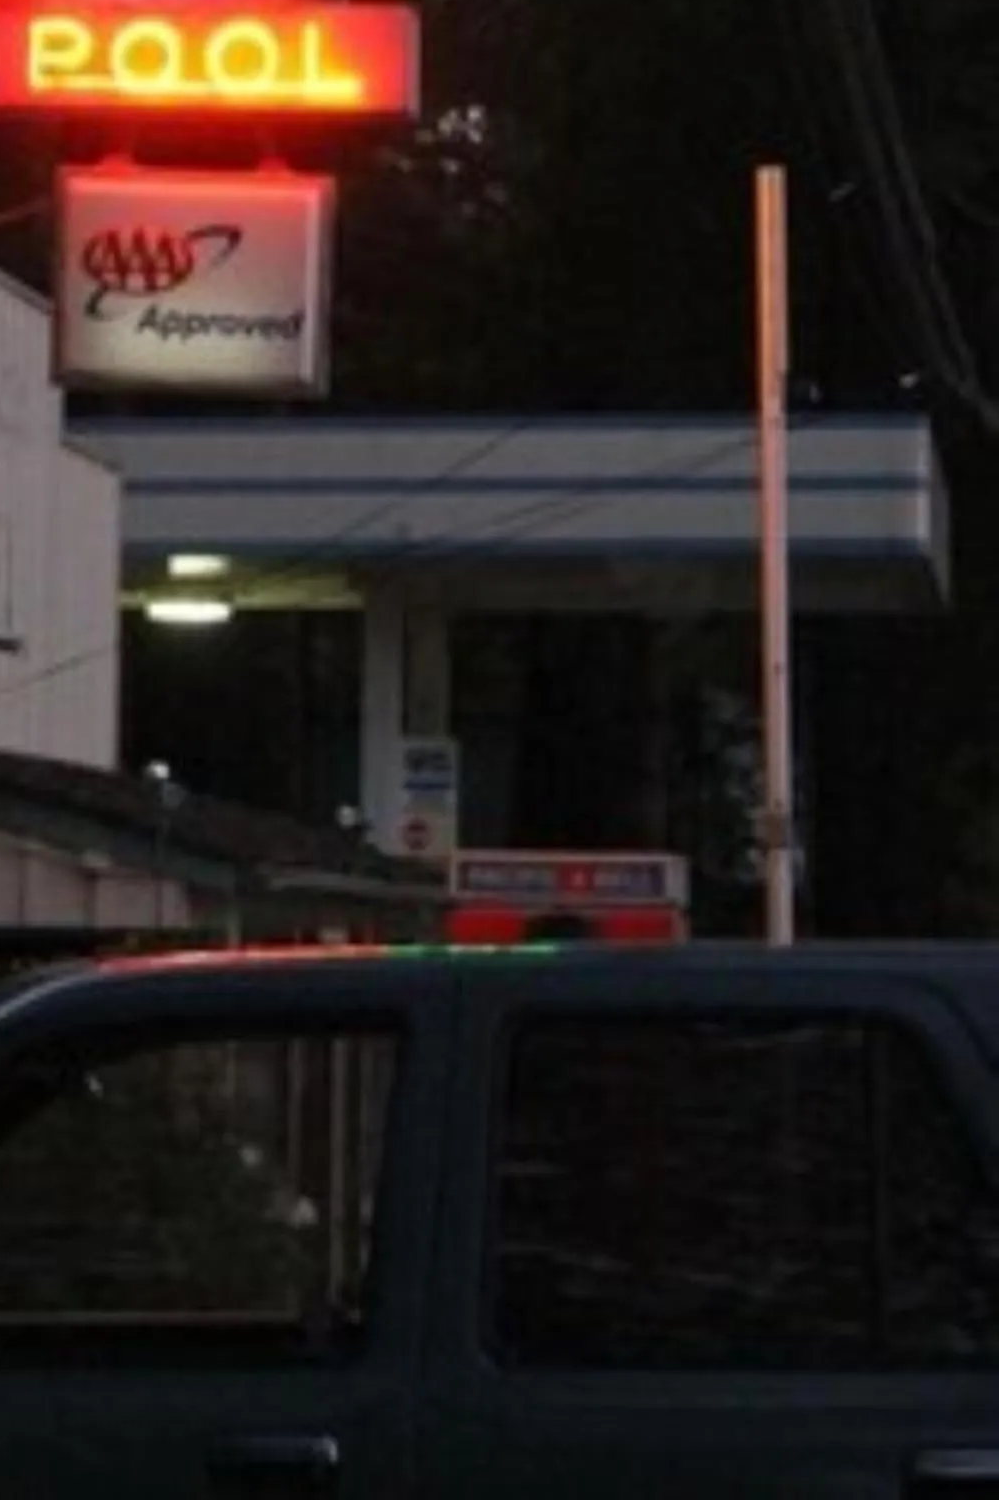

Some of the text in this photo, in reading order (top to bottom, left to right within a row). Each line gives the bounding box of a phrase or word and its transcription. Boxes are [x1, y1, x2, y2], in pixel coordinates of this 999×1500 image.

[29, 19, 362, 100] POOL
[84, 228, 193, 295] AAA
[138, 304, 304, 344] Approved
